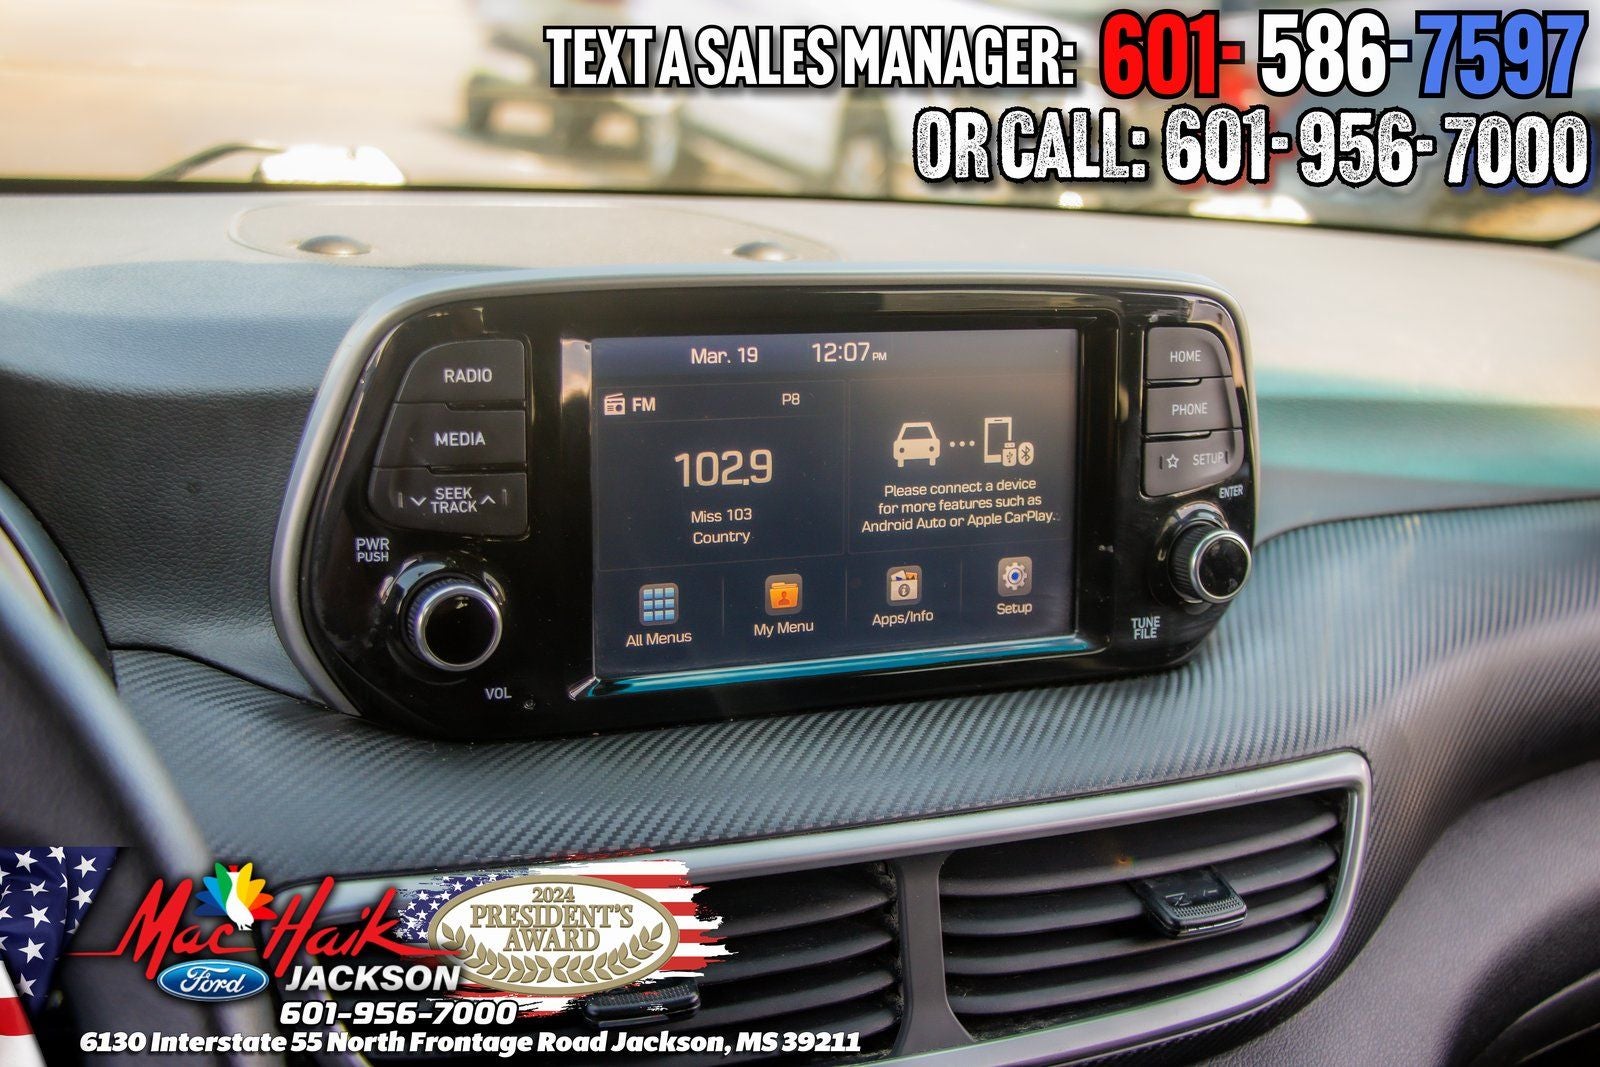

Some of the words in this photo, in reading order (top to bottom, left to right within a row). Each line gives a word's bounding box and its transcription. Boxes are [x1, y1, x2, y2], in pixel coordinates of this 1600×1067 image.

[690, 347, 731, 364] Mar.
[738, 347, 759, 363] 19
[812, 342, 870, 363] 12:07
[872, 352, 887, 361] PM
[1170, 350, 1201, 363] HOME
[444, 369, 493, 384] RADIO
[632, 397, 656, 412] FM
[782, 392, 800, 406] P8
[1172, 403, 1208, 416] PHONE
[435, 431, 486, 447] MEDIA
[1193, 453, 1224, 466] SETUP
[674, 449, 773, 487] 102.9
[435, 487, 473, 501] SEEK
[884, 484, 927, 498] Please
[930, 481, 982, 495] connect
[986, 483, 993, 492] a
[997, 479, 1036, 492] device
[1219, 485, 1243, 499] ENTER
[430, 500, 478, 514] TRACK
[878, 502, 899, 515] for
[901, 504, 936, 513] more
[939, 498, 993, 512] features
[995, 495, 1025, 508] such
[1027, 496, 1042, 506] as
[691, 510, 722, 523] Miss
[726, 508, 753, 521] 103
[861, 518, 913, 533] Android
[916, 517, 946, 530] Auto
[950, 517, 965, 527] or
[967, 513, 1002, 528] Apple
[1004, 510, 1056, 525] CarPlay.
[356, 538, 390, 551] PWR
[693, 530, 751, 545] Country
[357, 550, 389, 563] PUSH
[997, 601, 1033, 618] Setup
[872, 609, 934, 627] Apps/Info
[1131, 616, 1160, 629] TUNE
[754, 623, 774, 640] My
[777, 619, 814, 635] Menu
[1134, 628, 1157, 640] FILE
[625, 633, 643, 648] All
[646, 630, 692, 647] Menus
[485, 687, 512, 700] VOL
